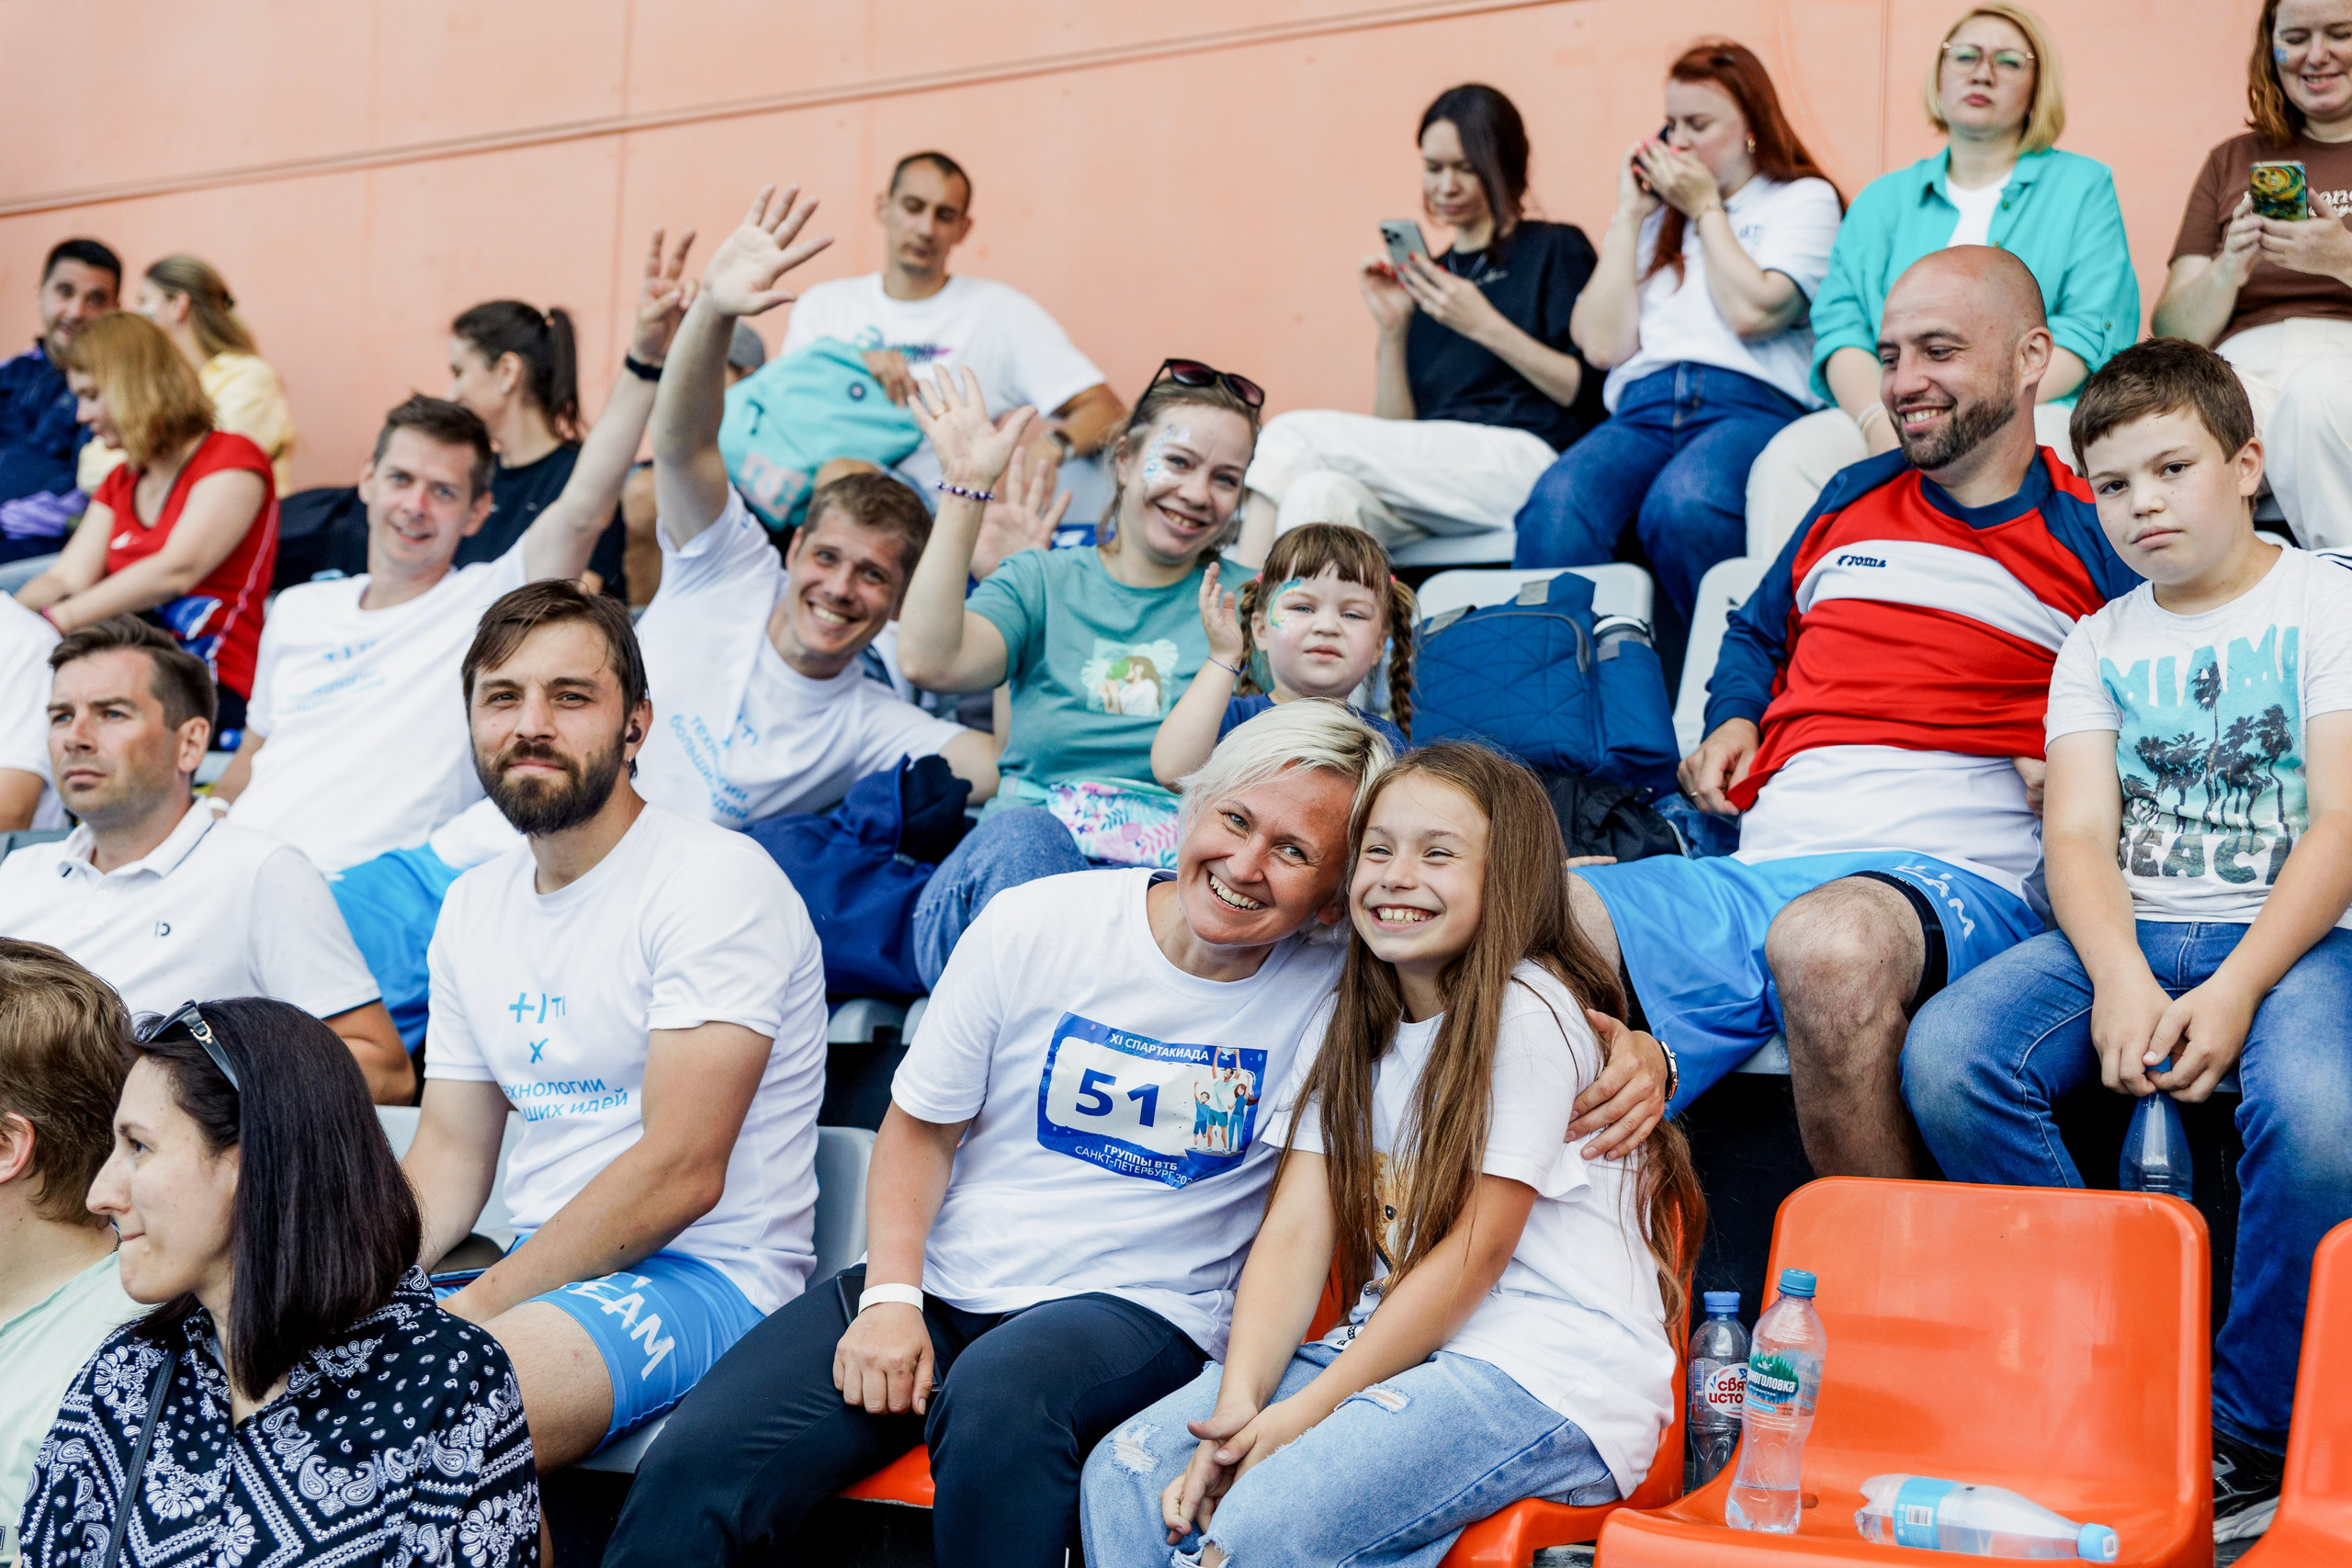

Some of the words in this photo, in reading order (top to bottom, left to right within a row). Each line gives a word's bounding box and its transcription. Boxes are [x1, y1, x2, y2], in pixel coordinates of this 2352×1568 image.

[2098, 623, 2301, 709] MIAMI
[1109, 1032, 1124, 1045] XI
[1125, 1038, 1209, 1062] СПАРТАКИАДА
[570, 1088, 628, 1114] идей
[1075, 1067, 1159, 1128] 51
[1075, 1145, 1174, 1179] САНКТ-ПЕТЕРБУРГ
[1103, 1144, 1152, 1168] ГРУППЫ
[1154, 1160, 1178, 1171] ВТБ
